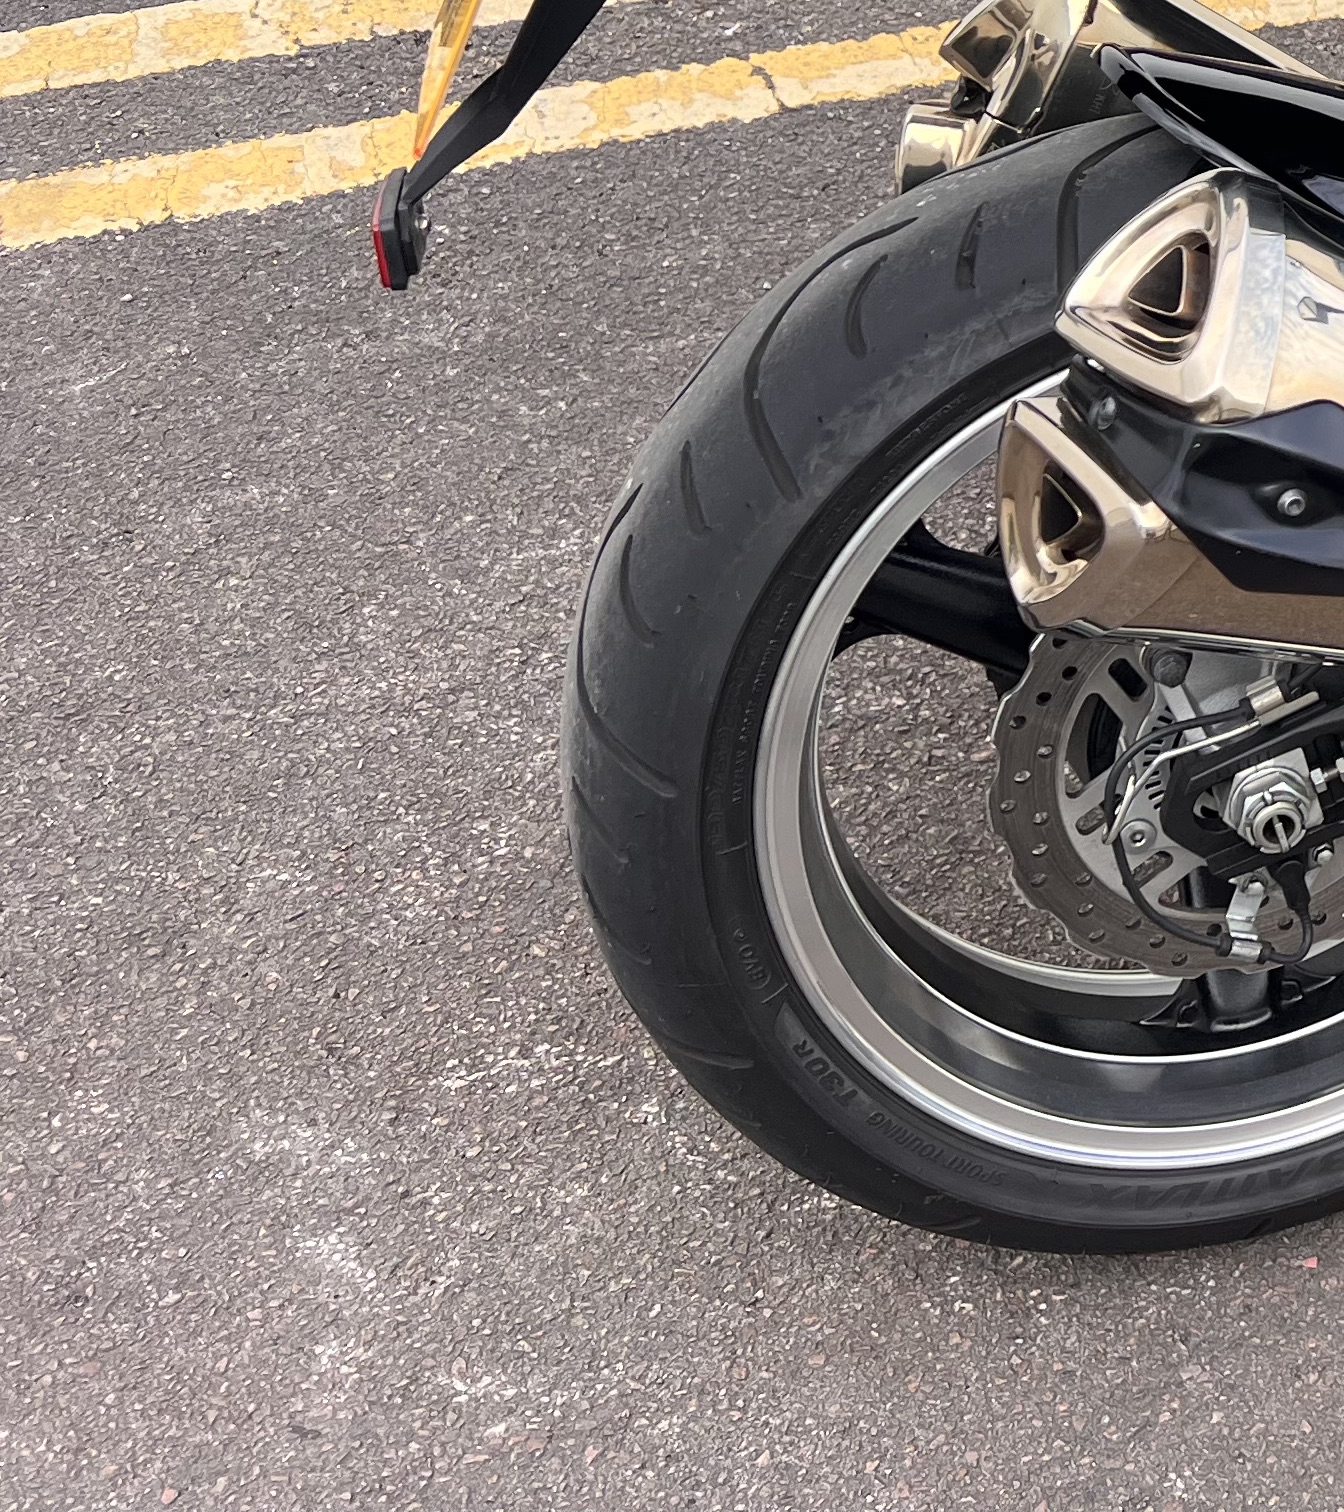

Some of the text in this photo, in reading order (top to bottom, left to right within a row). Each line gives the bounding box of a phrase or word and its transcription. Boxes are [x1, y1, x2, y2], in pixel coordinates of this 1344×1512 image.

[794, 1040, 858, 1107] T30R
[868, 1111, 943, 1162] TOURING
[946, 1154, 1008, 1186] SPORT
